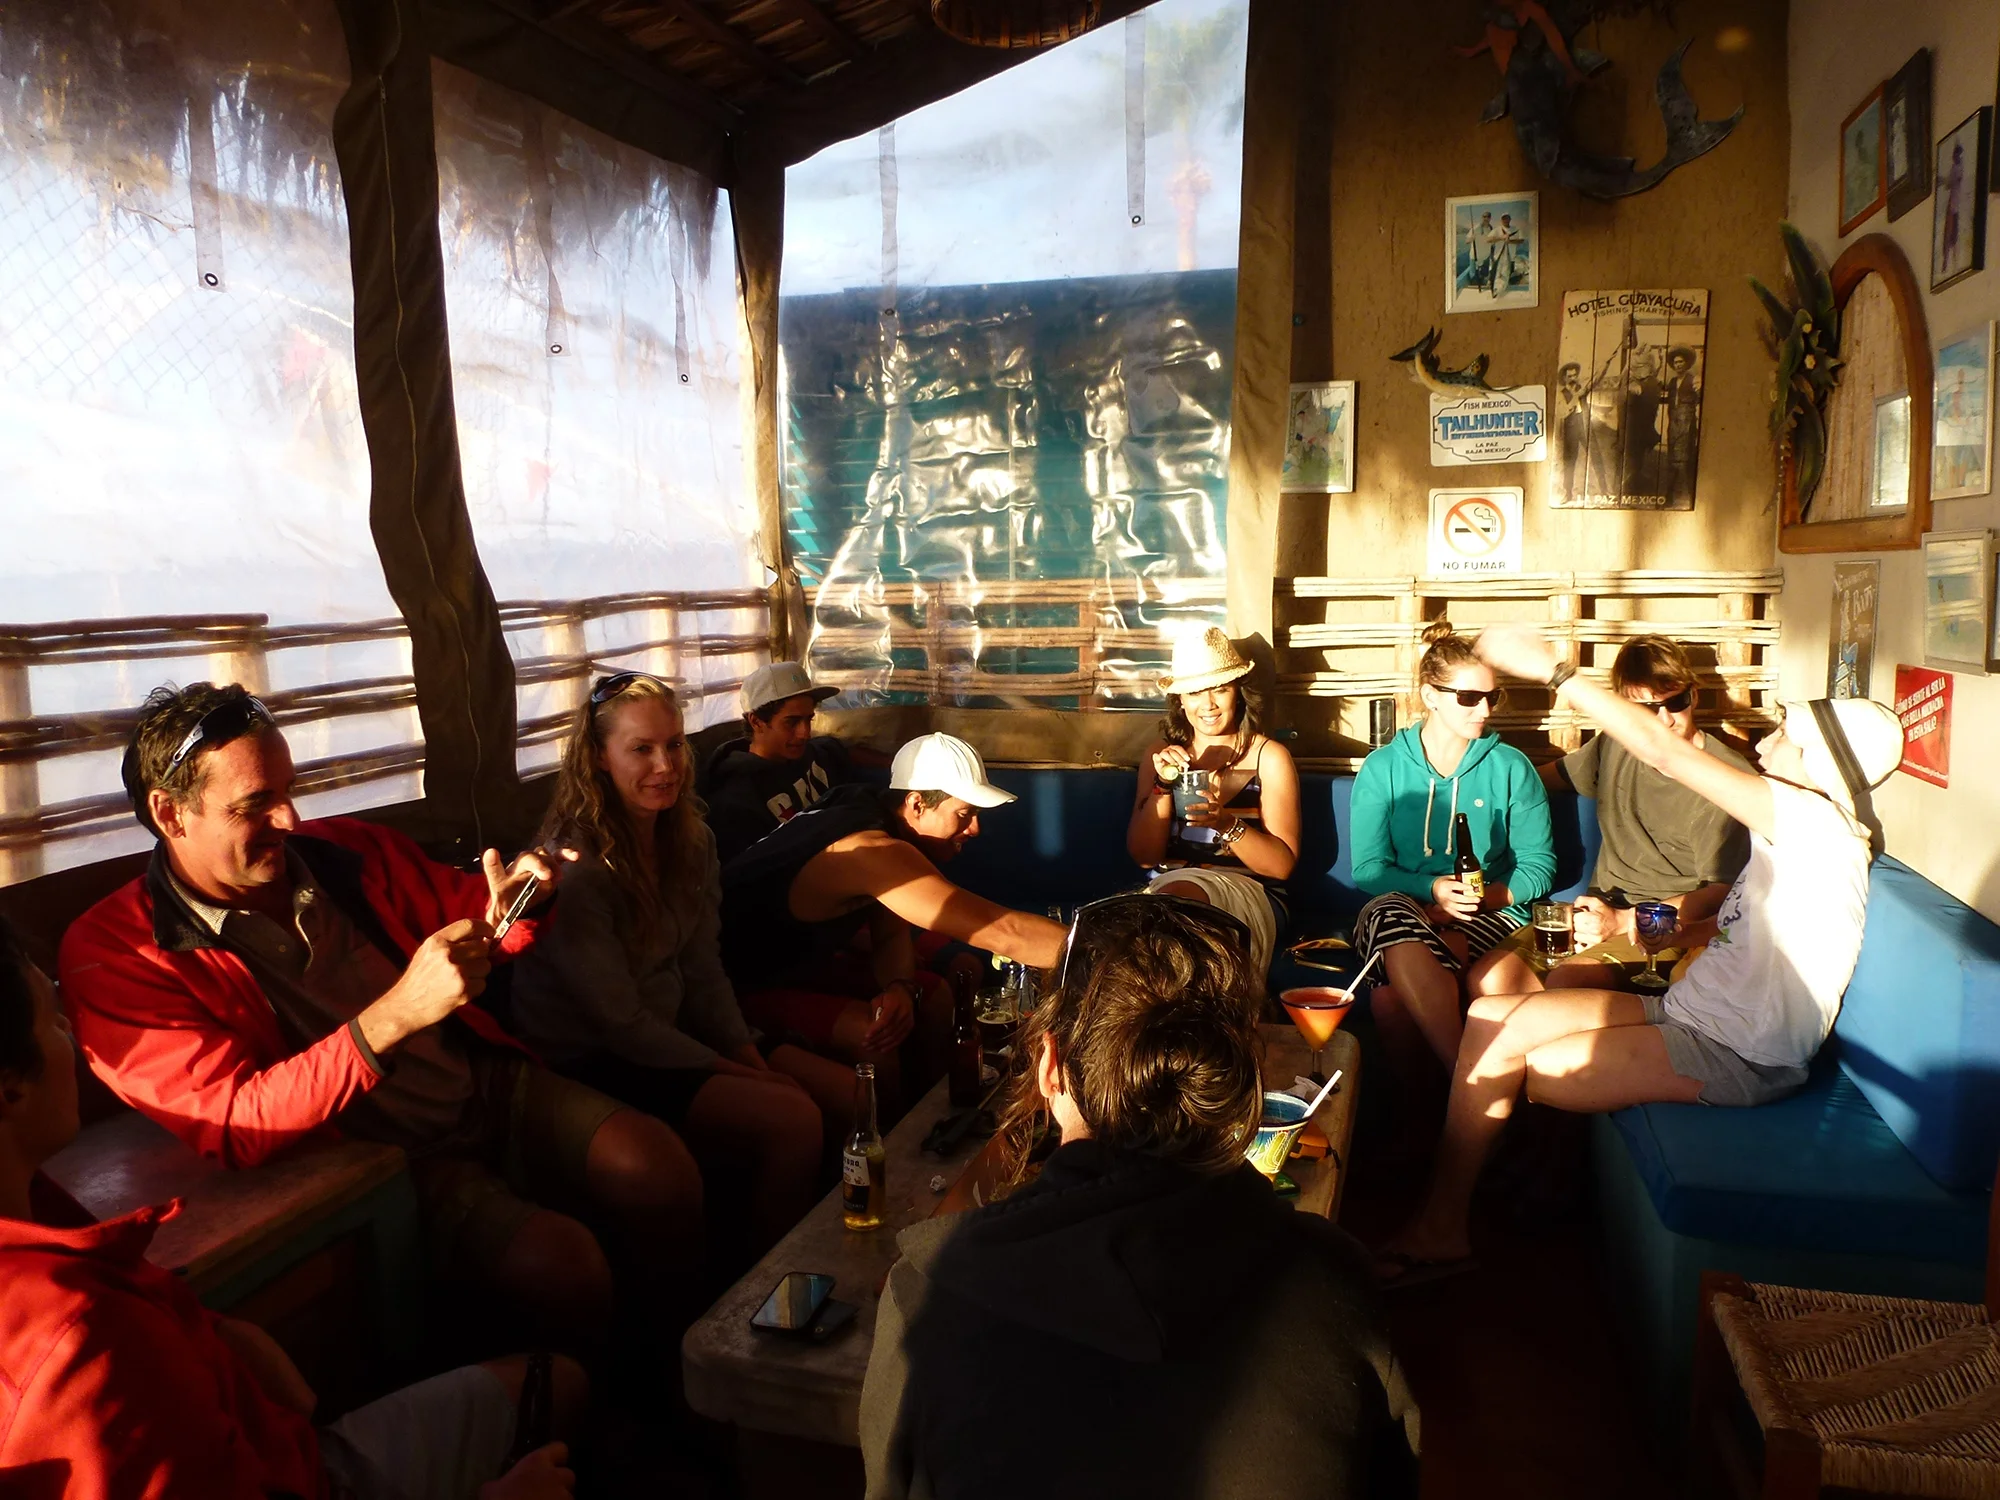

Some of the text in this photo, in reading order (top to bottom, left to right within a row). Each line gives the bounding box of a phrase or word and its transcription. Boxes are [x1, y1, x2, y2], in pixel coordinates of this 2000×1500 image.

[1567, 292, 1701, 317] HOTEL GUAYACURA
[1593, 306, 1628, 318] FISHING
[1463, 400, 1511, 410] FISH MEXICO!
[1438, 411, 1539, 440] TAILHUNTER
[1451, 430, 1522, 440] INTERNATIONAL
[1621, 495, 1666, 505] MEXICO
[1443, 561, 1506, 570] NO FUMAR
